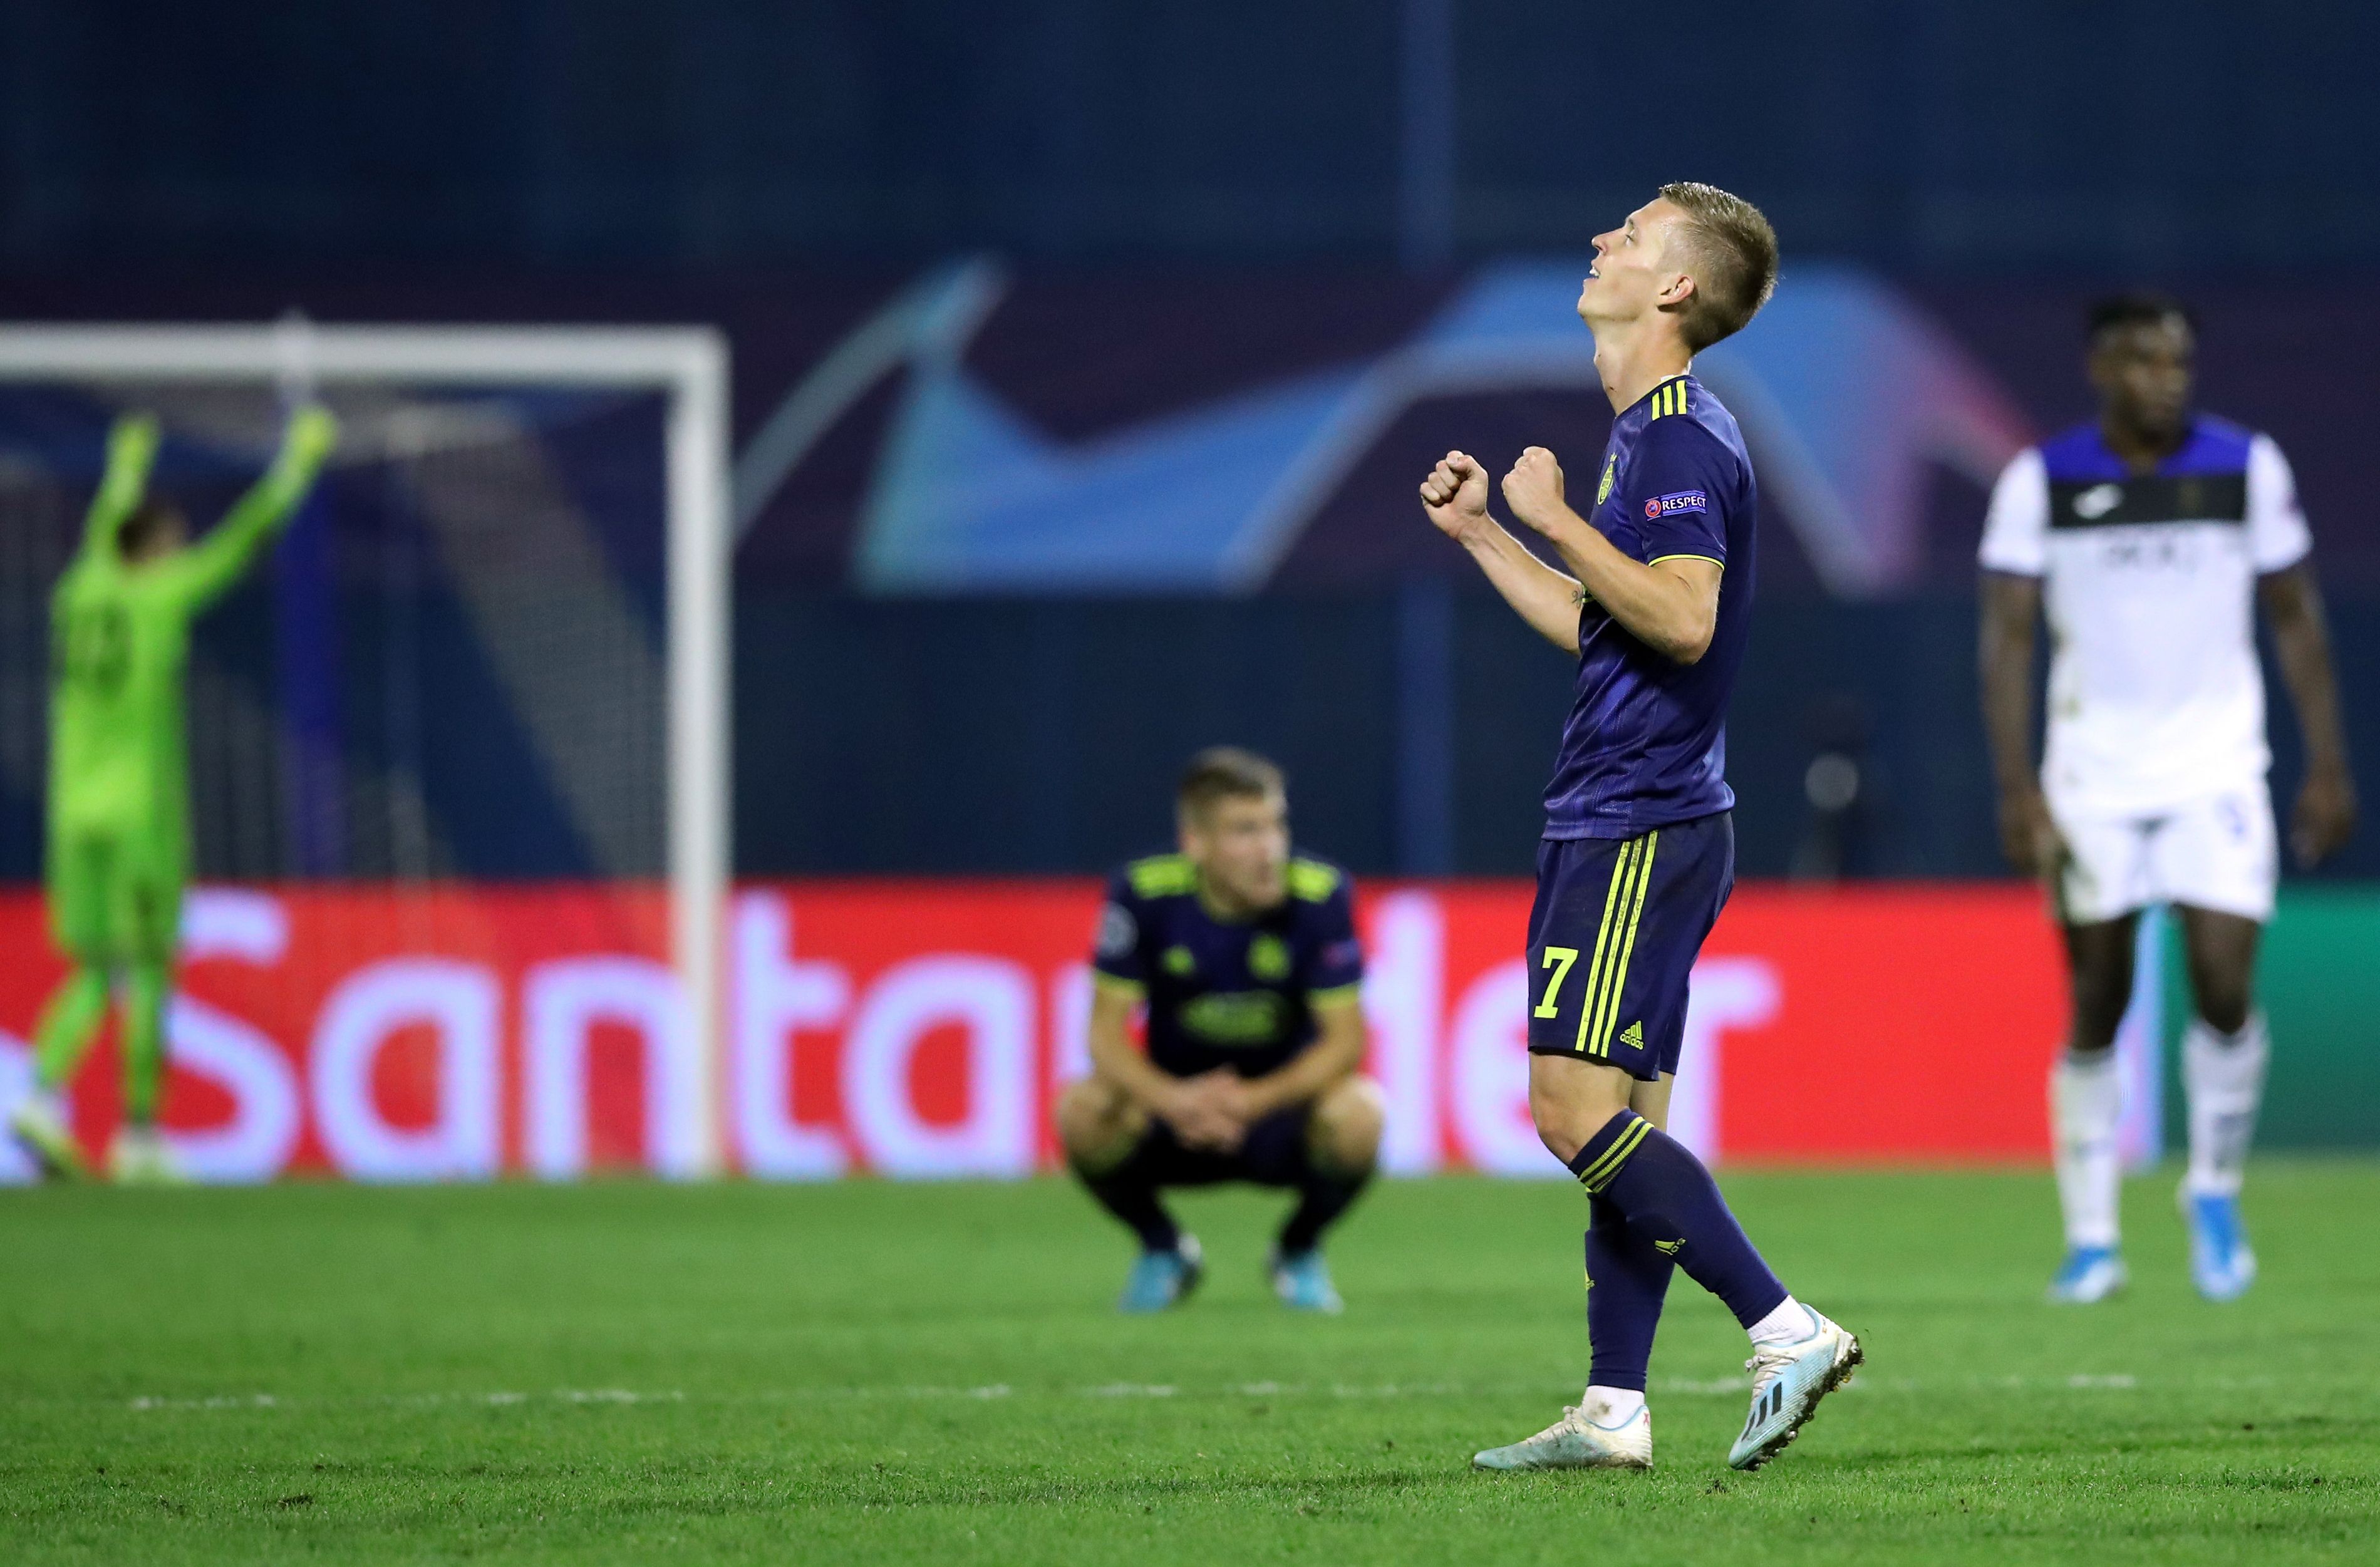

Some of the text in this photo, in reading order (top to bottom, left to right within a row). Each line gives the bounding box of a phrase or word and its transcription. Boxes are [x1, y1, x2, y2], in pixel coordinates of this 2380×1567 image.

[1662, 495, 1706, 510] RESPECT
[1533, 946, 1578, 1019] 7
[116, 883, 1784, 1182] Santaer
[1620, 1033, 1644, 1050] adidas
